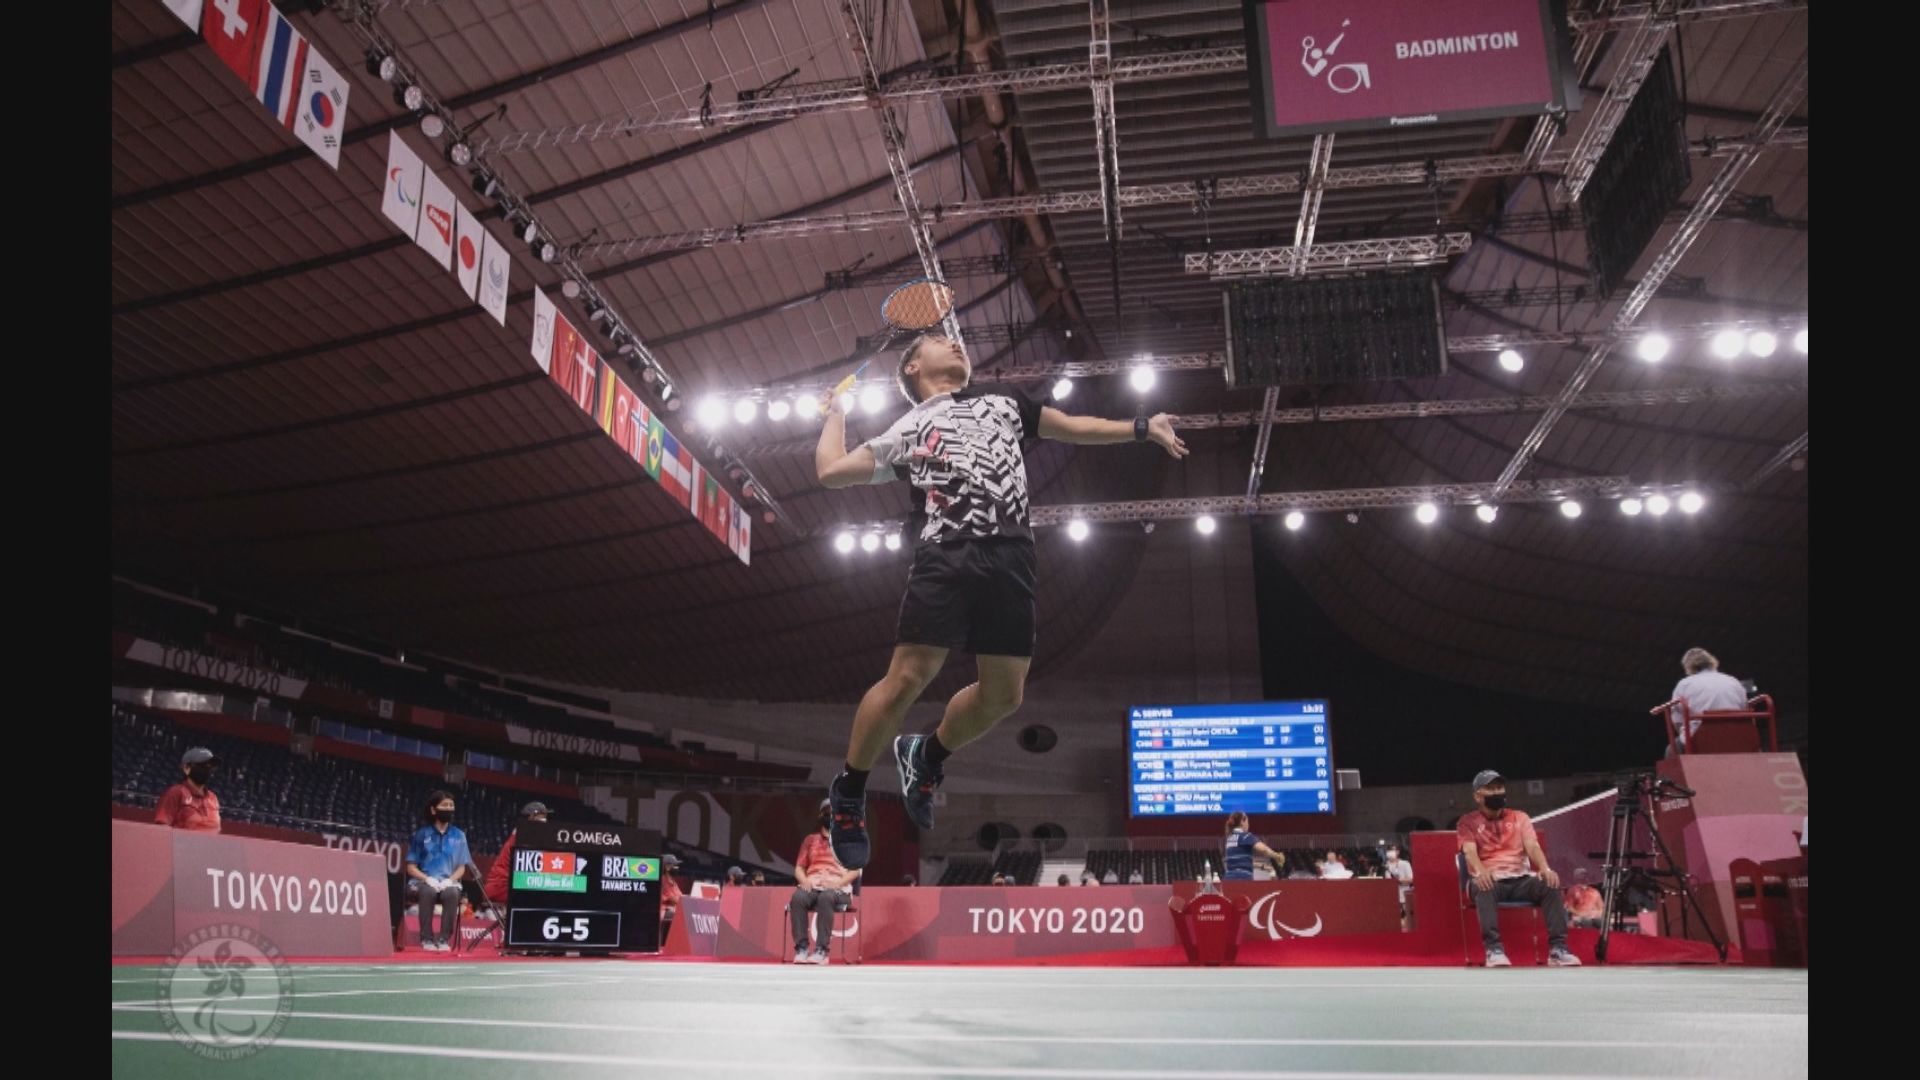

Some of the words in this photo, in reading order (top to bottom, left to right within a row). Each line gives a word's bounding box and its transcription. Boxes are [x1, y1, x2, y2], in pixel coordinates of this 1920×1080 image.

[1396, 31, 1519, 60] BADMINTON
[232, 664, 281, 695] 2020
[573, 831, 622, 846] OMEGA
[514, 850, 544, 873] HKG
[602, 856, 630, 878] BRA
[206, 867, 303, 914] TOKYO
[308, 877, 368, 917] 2020
[601, 880, 632, 892] TAVARES
[542, 916, 590, 942] 6-5
[968, 907, 1064, 934] TOKYO
[1071, 907, 1144, 934] 2020
